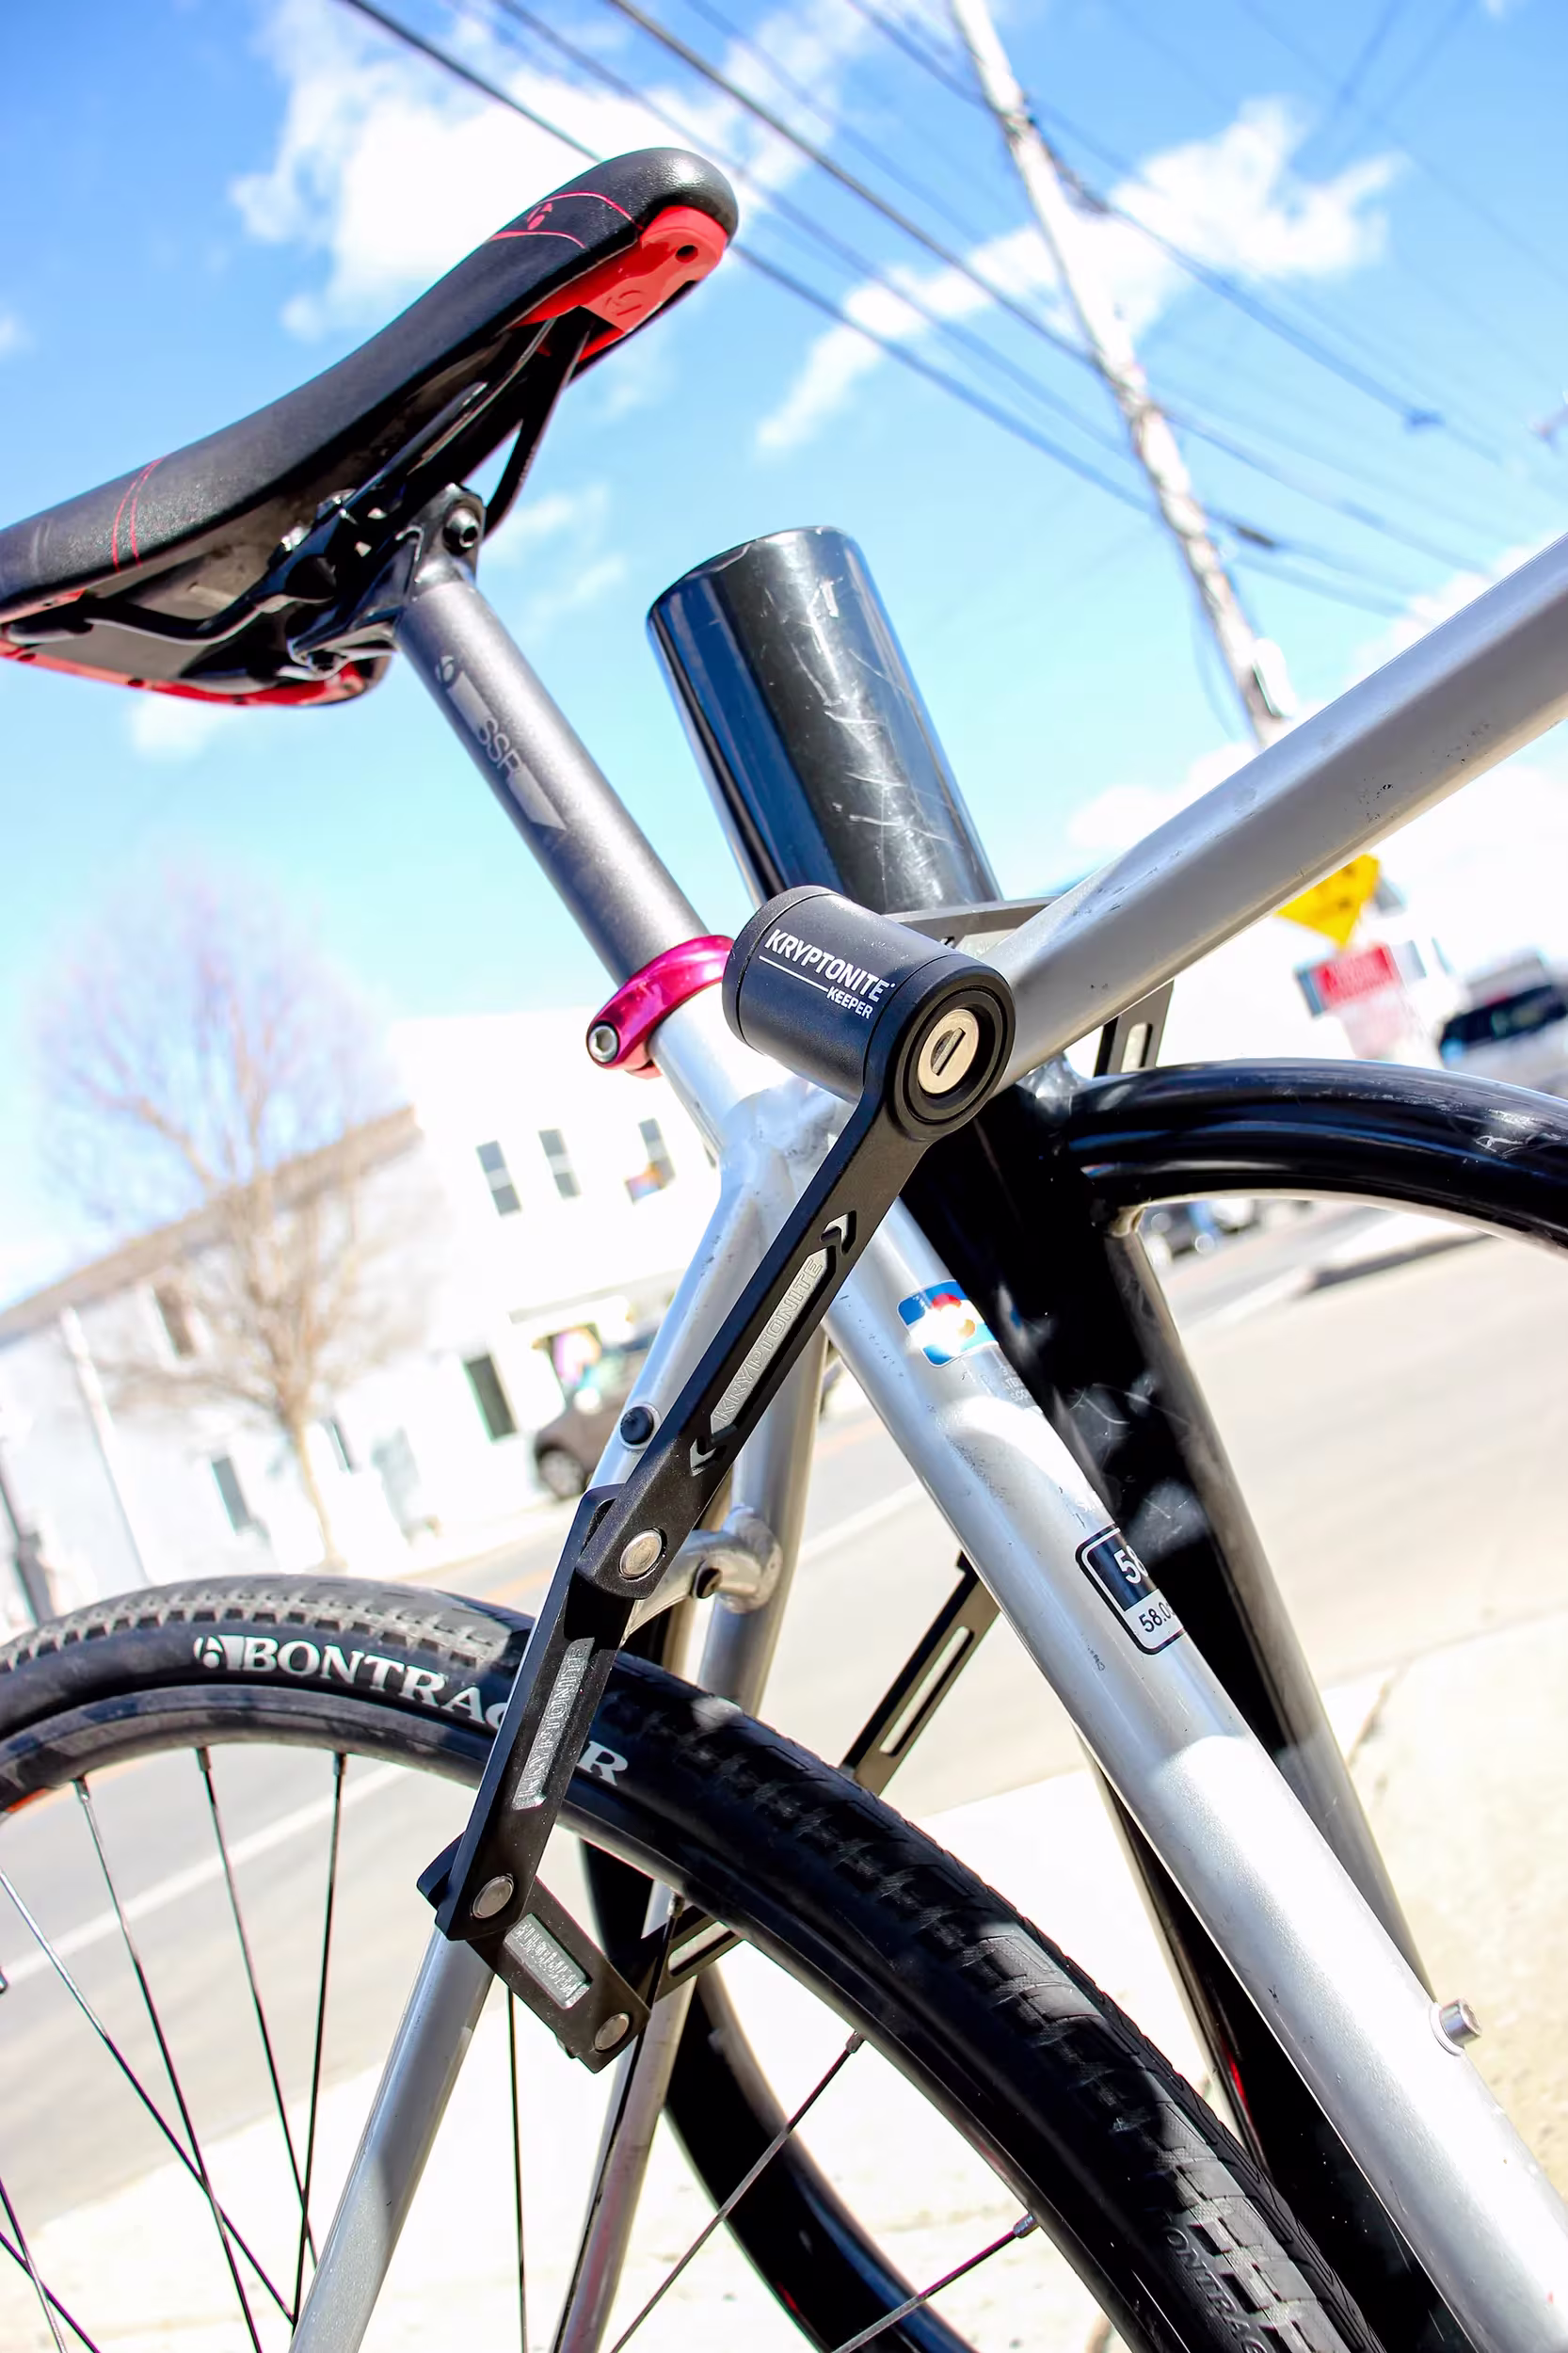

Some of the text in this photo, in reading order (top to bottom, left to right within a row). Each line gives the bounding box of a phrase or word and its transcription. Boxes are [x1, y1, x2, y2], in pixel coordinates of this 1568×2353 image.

[764, 929, 891, 1002] KRYPTONITE
[825, 985, 873, 1019] KEEPER
[712, 1257, 824, 1423] KRYPTONITE
[1138, 1602, 1176, 1632] 58.0
[242, 1635, 628, 1786] BONTRAR
